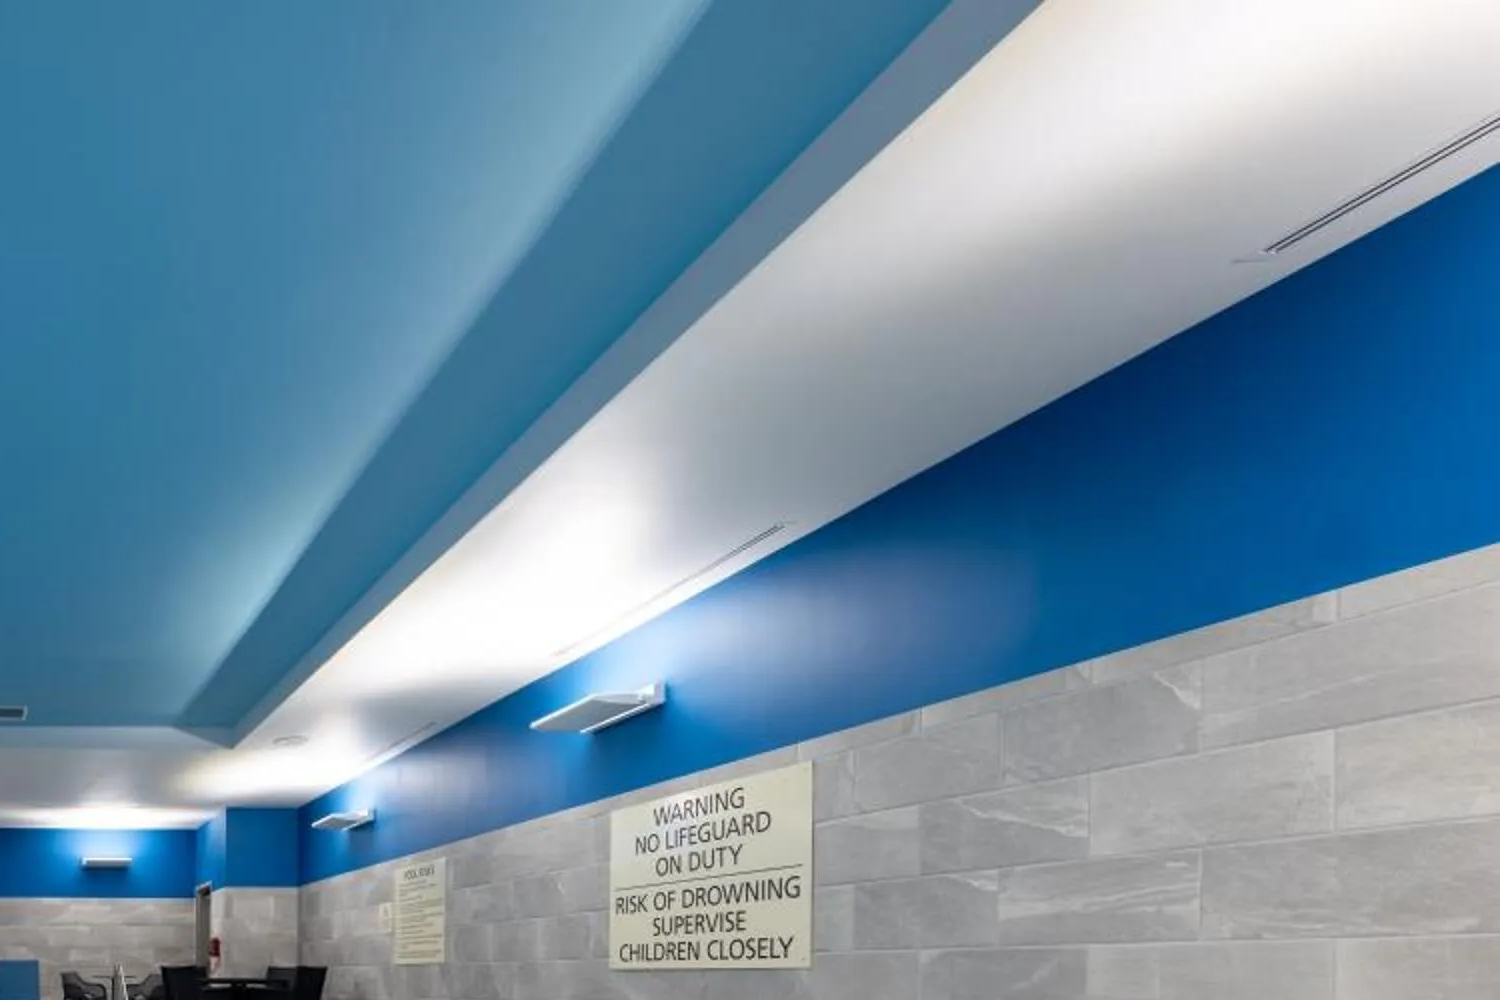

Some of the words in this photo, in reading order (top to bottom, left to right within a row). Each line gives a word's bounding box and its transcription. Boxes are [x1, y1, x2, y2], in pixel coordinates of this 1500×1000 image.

[653, 787, 745, 827] WARNING
[635, 833, 660, 856] NO
[665, 811, 772, 851] LIFEGUARD
[655, 855, 682, 877] ON
[688, 843, 744, 872] DUTY
[615, 893, 648, 915] RISK
[653, 890, 676, 912] OF
[681, 875, 801, 909] DROWNING
[652, 910, 747, 937] SUPERVISE
[619, 941, 700, 963] CHILDREN
[707, 935, 795, 961] CLOSELY
